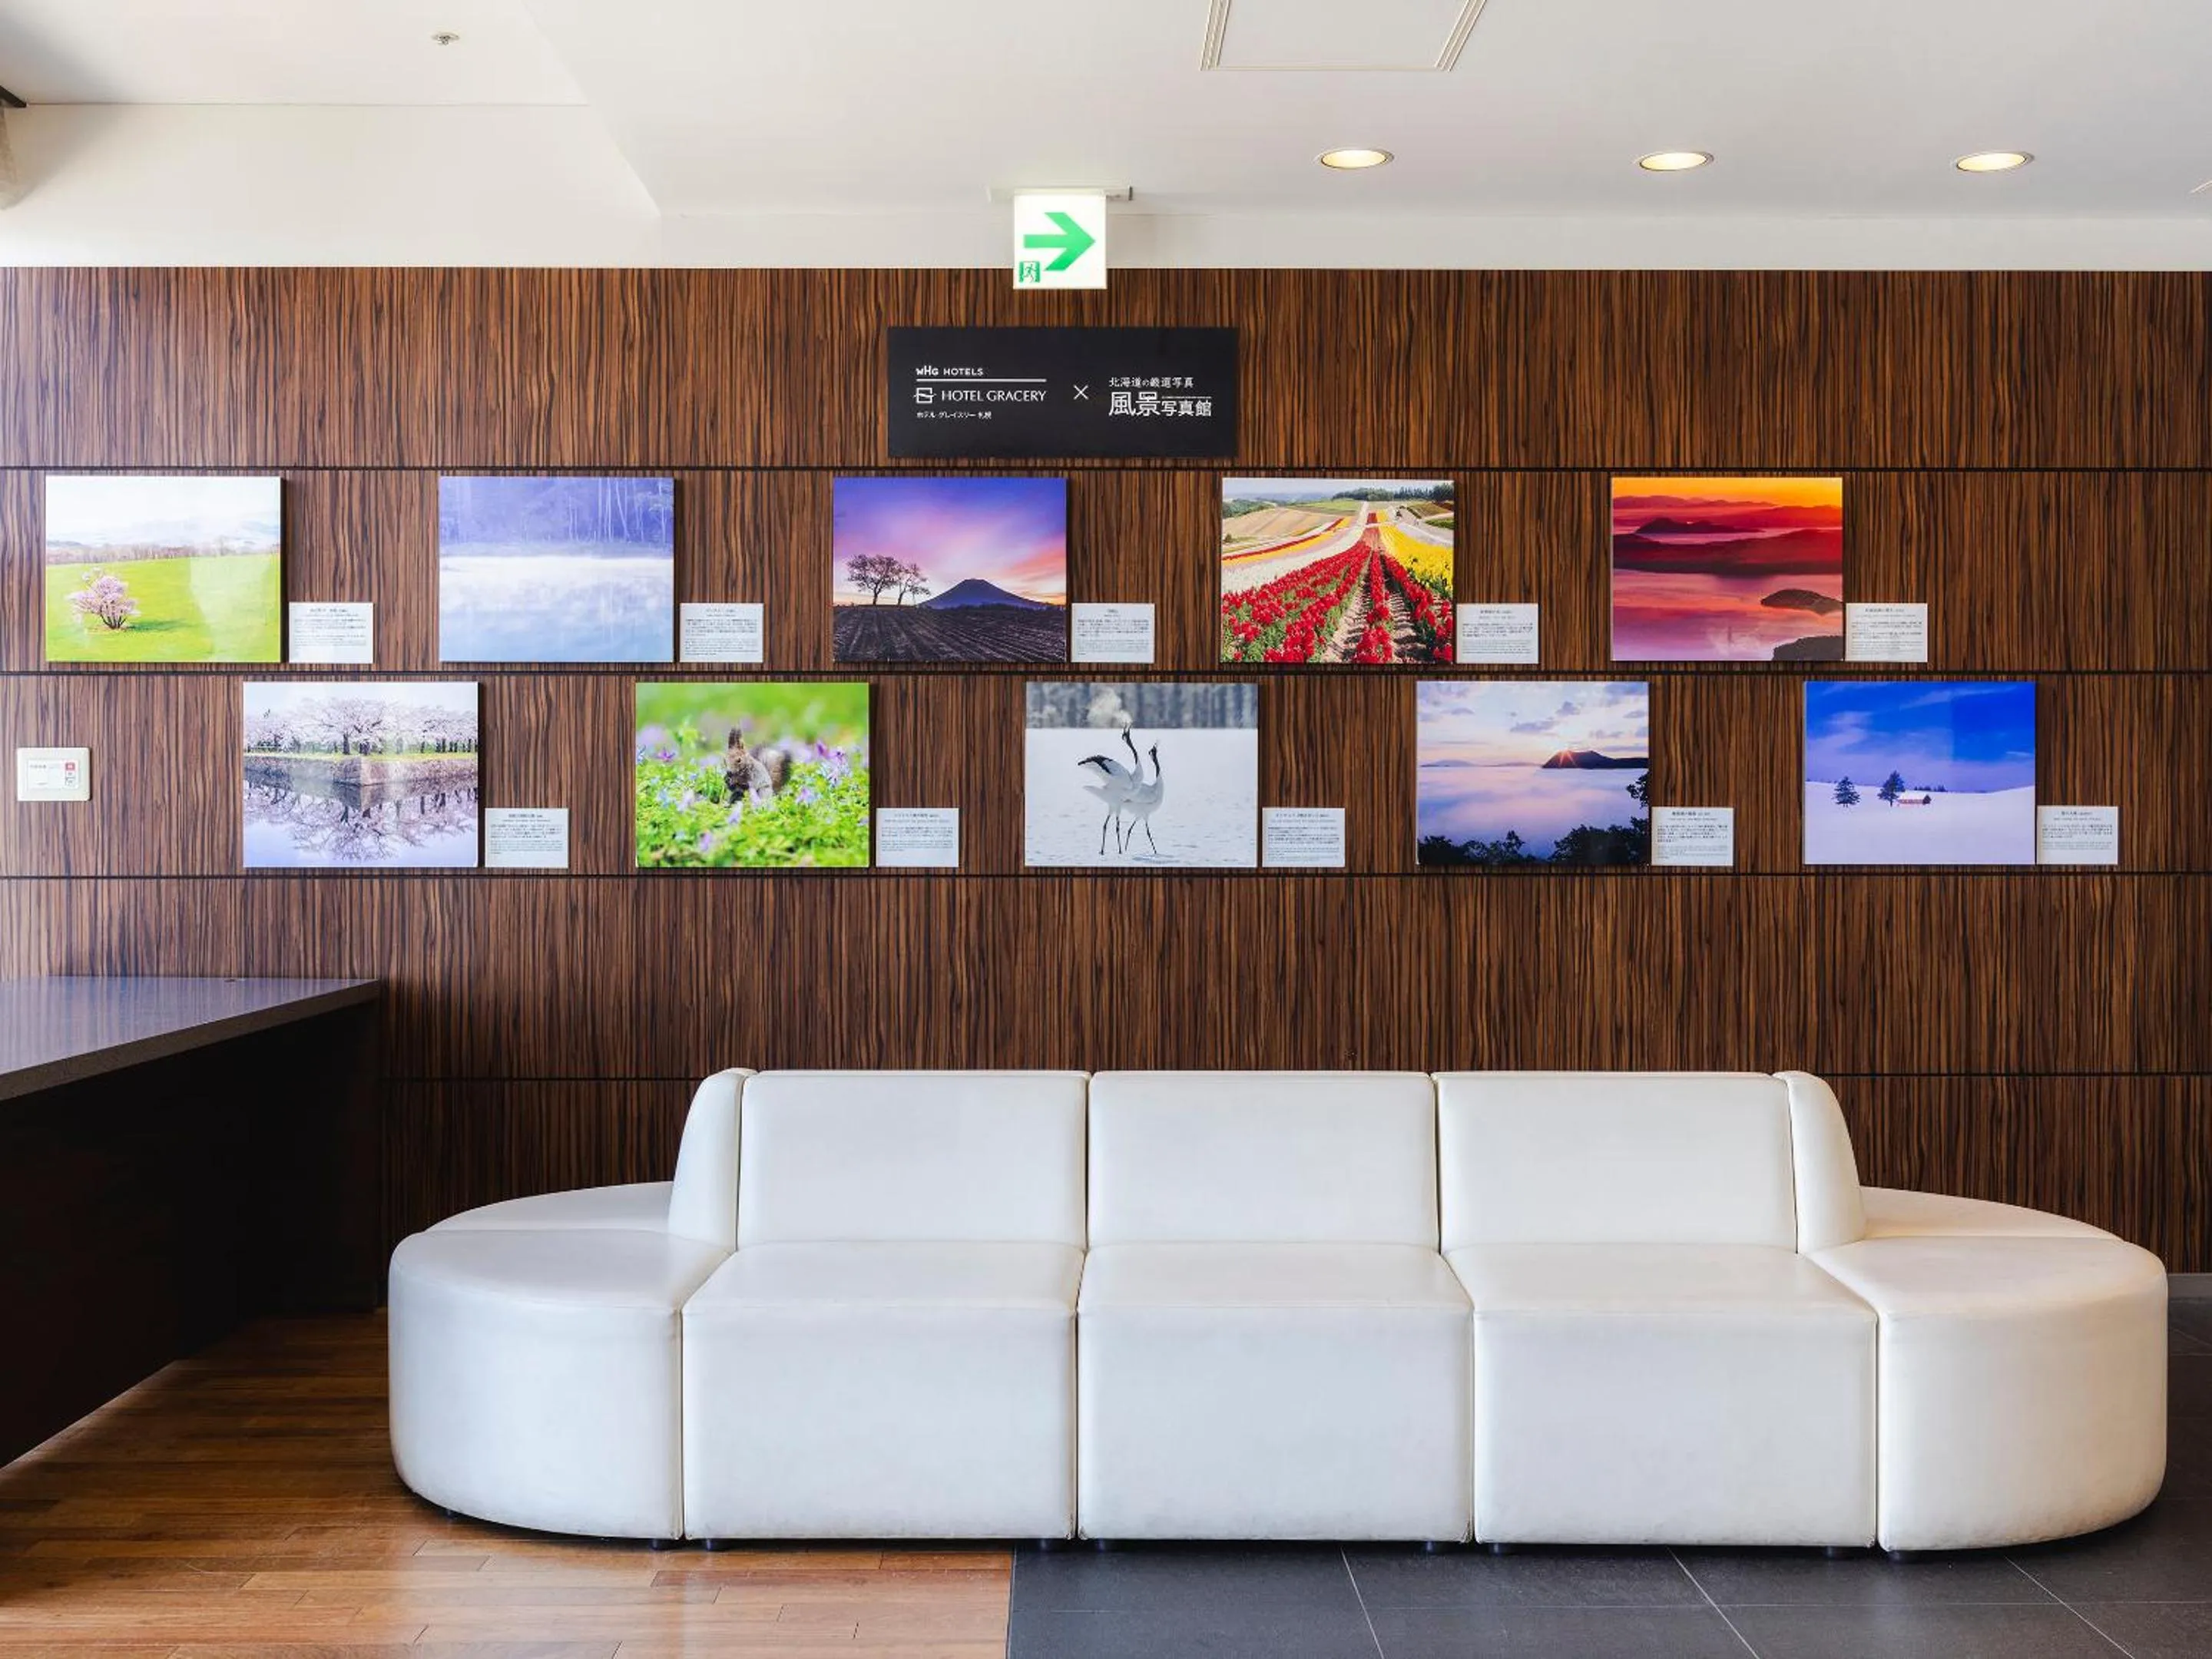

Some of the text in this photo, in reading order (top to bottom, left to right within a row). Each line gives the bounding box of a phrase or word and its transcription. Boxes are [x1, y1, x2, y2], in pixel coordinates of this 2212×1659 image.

[942, 390, 1047, 402] HOTEL GRACERY
[1108, 391, 1212, 416] 風景写真館
